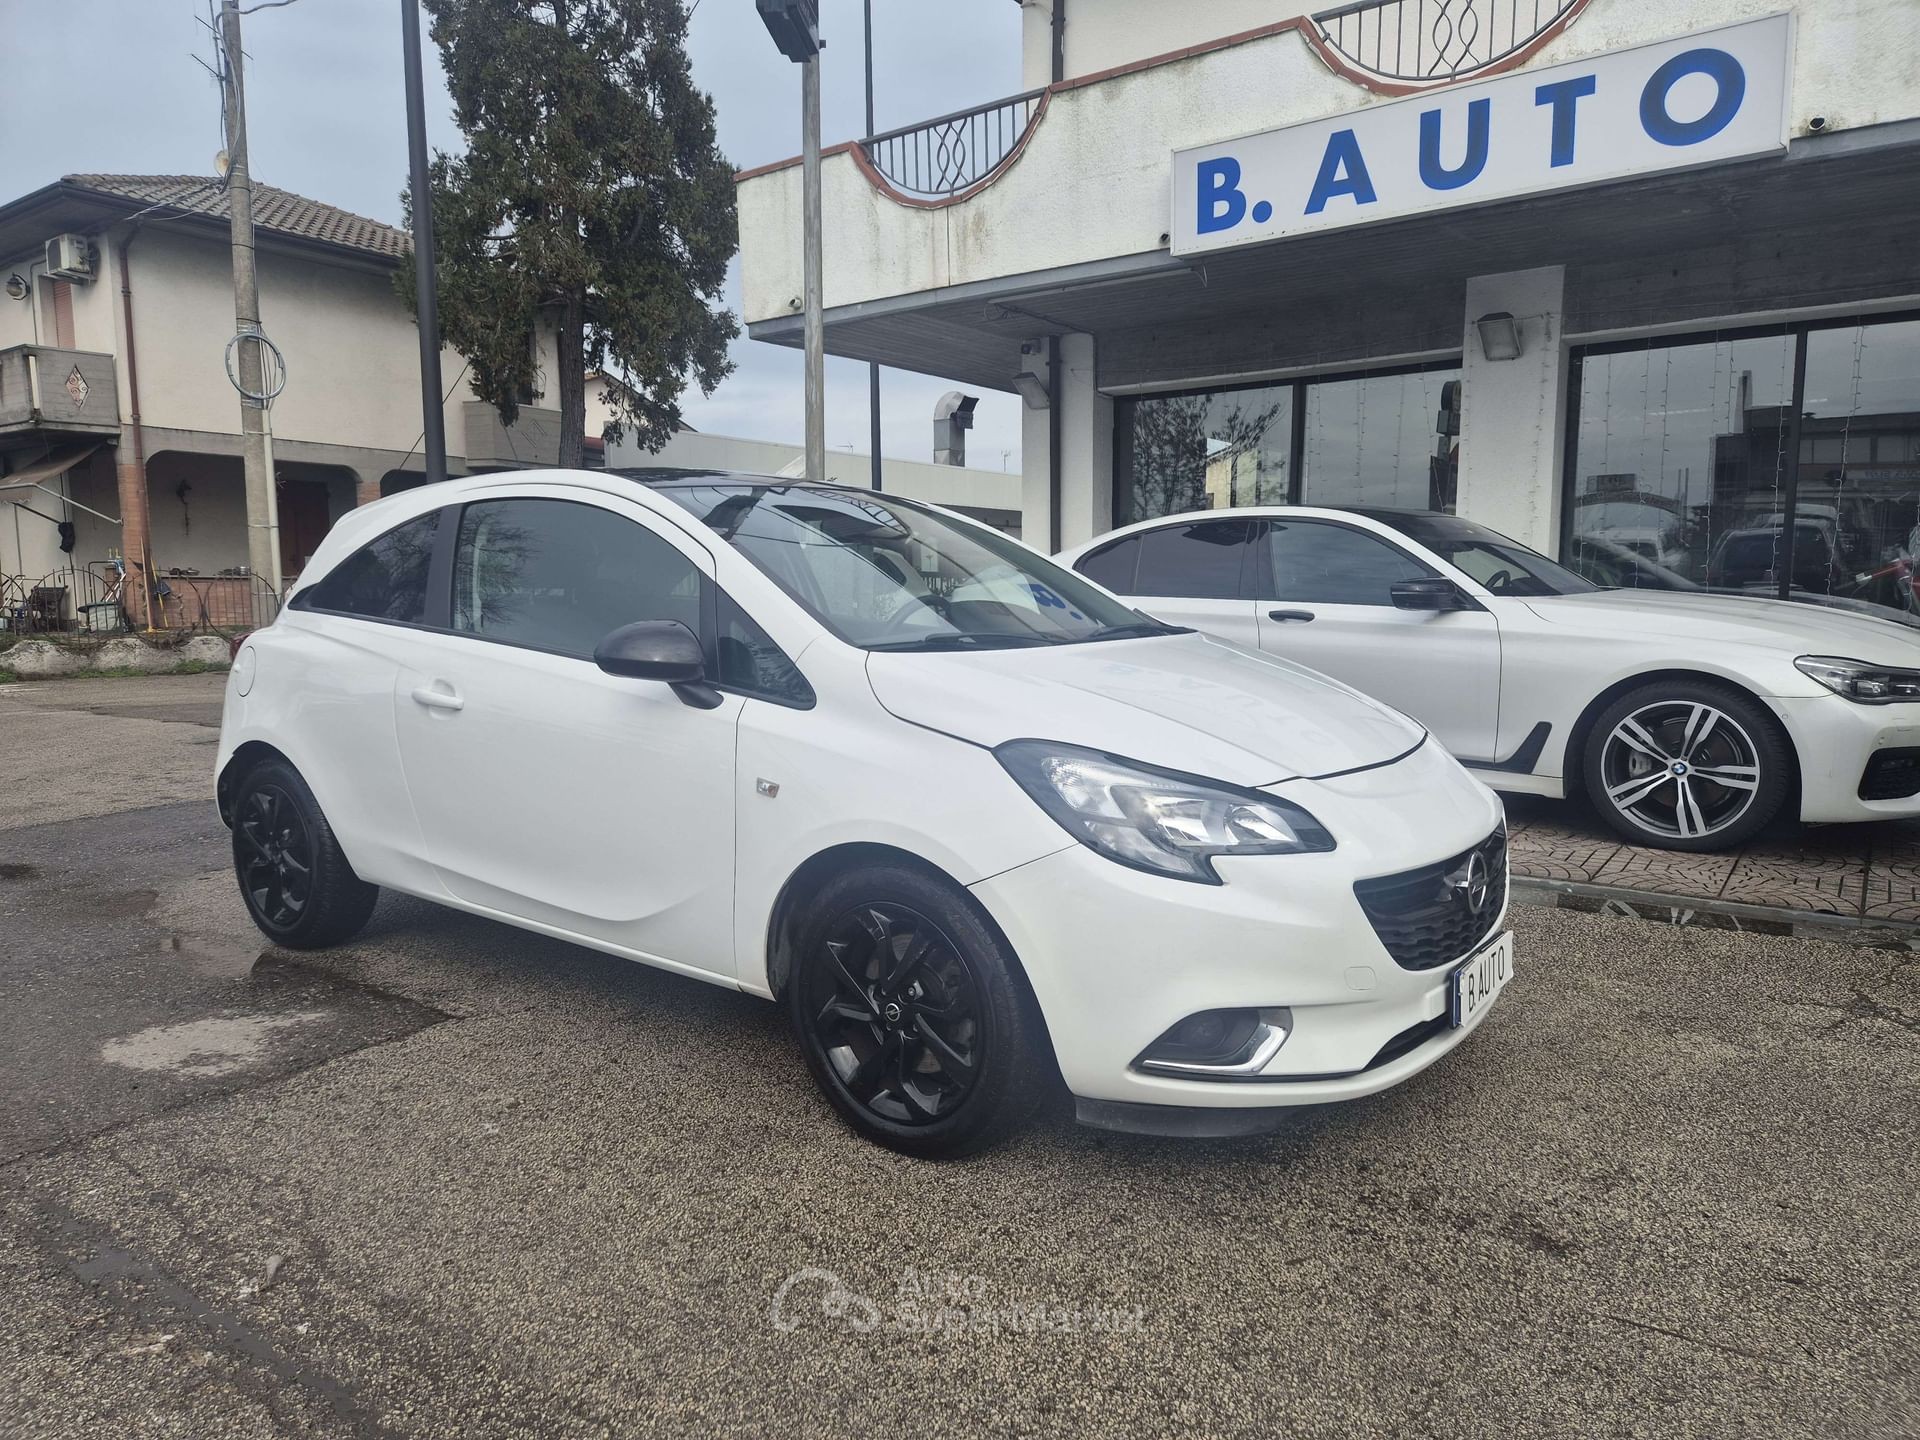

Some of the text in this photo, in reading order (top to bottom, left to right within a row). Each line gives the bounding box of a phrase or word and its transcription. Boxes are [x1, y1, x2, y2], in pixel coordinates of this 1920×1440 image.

[1197, 48, 1746, 234] B. AUTO
[1478, 945, 1505, 1001] AUTO
